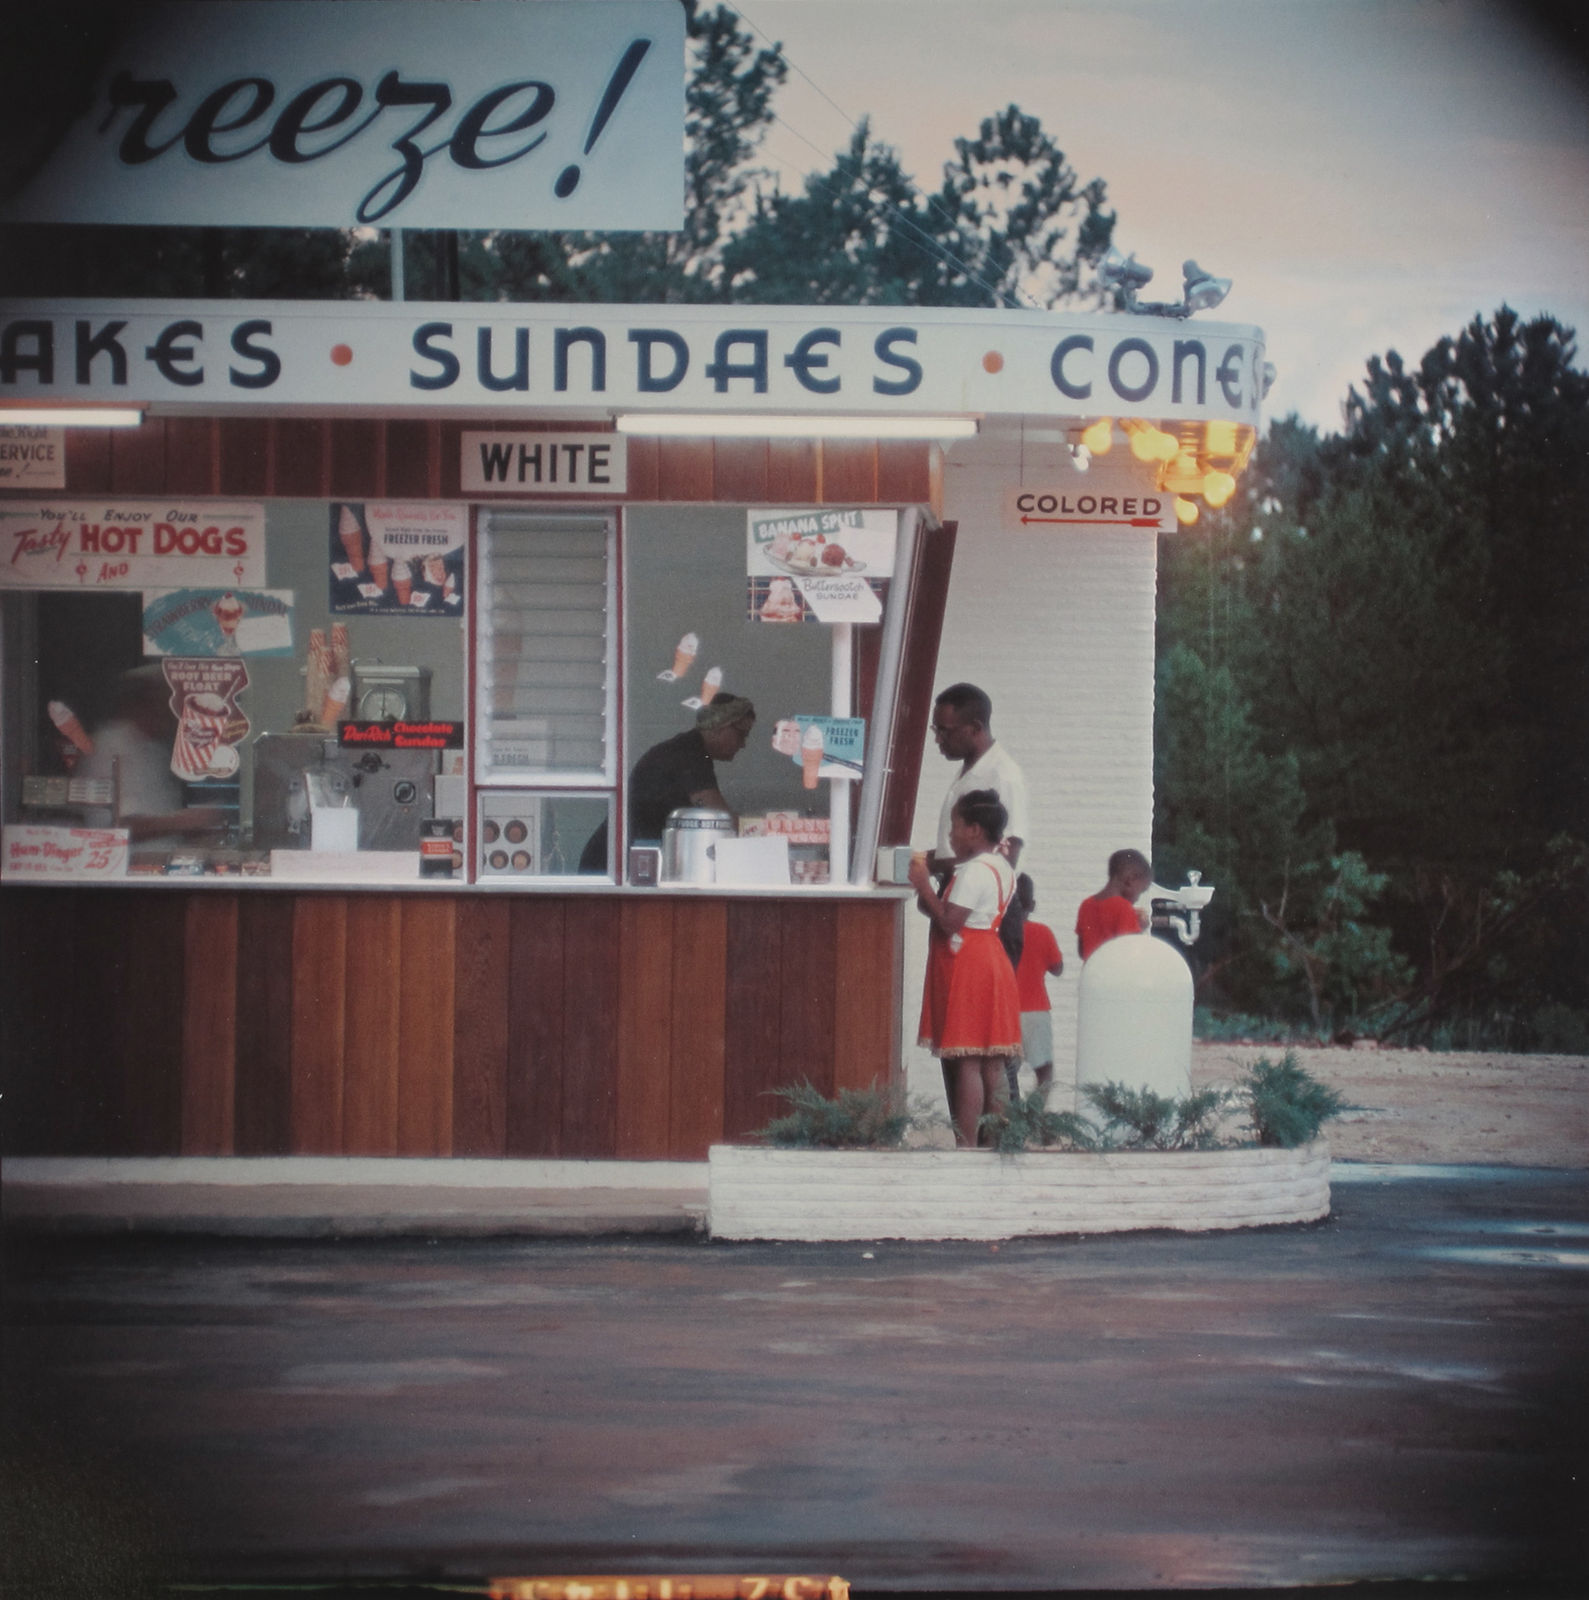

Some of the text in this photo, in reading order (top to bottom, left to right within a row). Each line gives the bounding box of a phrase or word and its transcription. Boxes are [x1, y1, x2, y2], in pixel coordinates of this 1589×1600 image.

[0, 319, 282, 387] AKES
[409, 321, 923, 396] SUNDAES
[481, 443, 611, 484] WHITE
[1016, 494, 1162, 515] COLORED
[104, 509, 152, 523] ENJOY
[166, 509, 199, 523] OUR
[758, 510, 858, 539] BANANA SPLIT
[11, 520, 248, 565] Tasty HOT DOGS
[383, 534, 449, 546] FREEZER FRESH
[97, 561, 129, 584] AND
[816, 592, 859, 601] SUNDAE
[171, 671, 233, 682] ROOT BEER
[183, 682, 220, 692] FLOAT
[830, 736, 856, 746] FRESH
